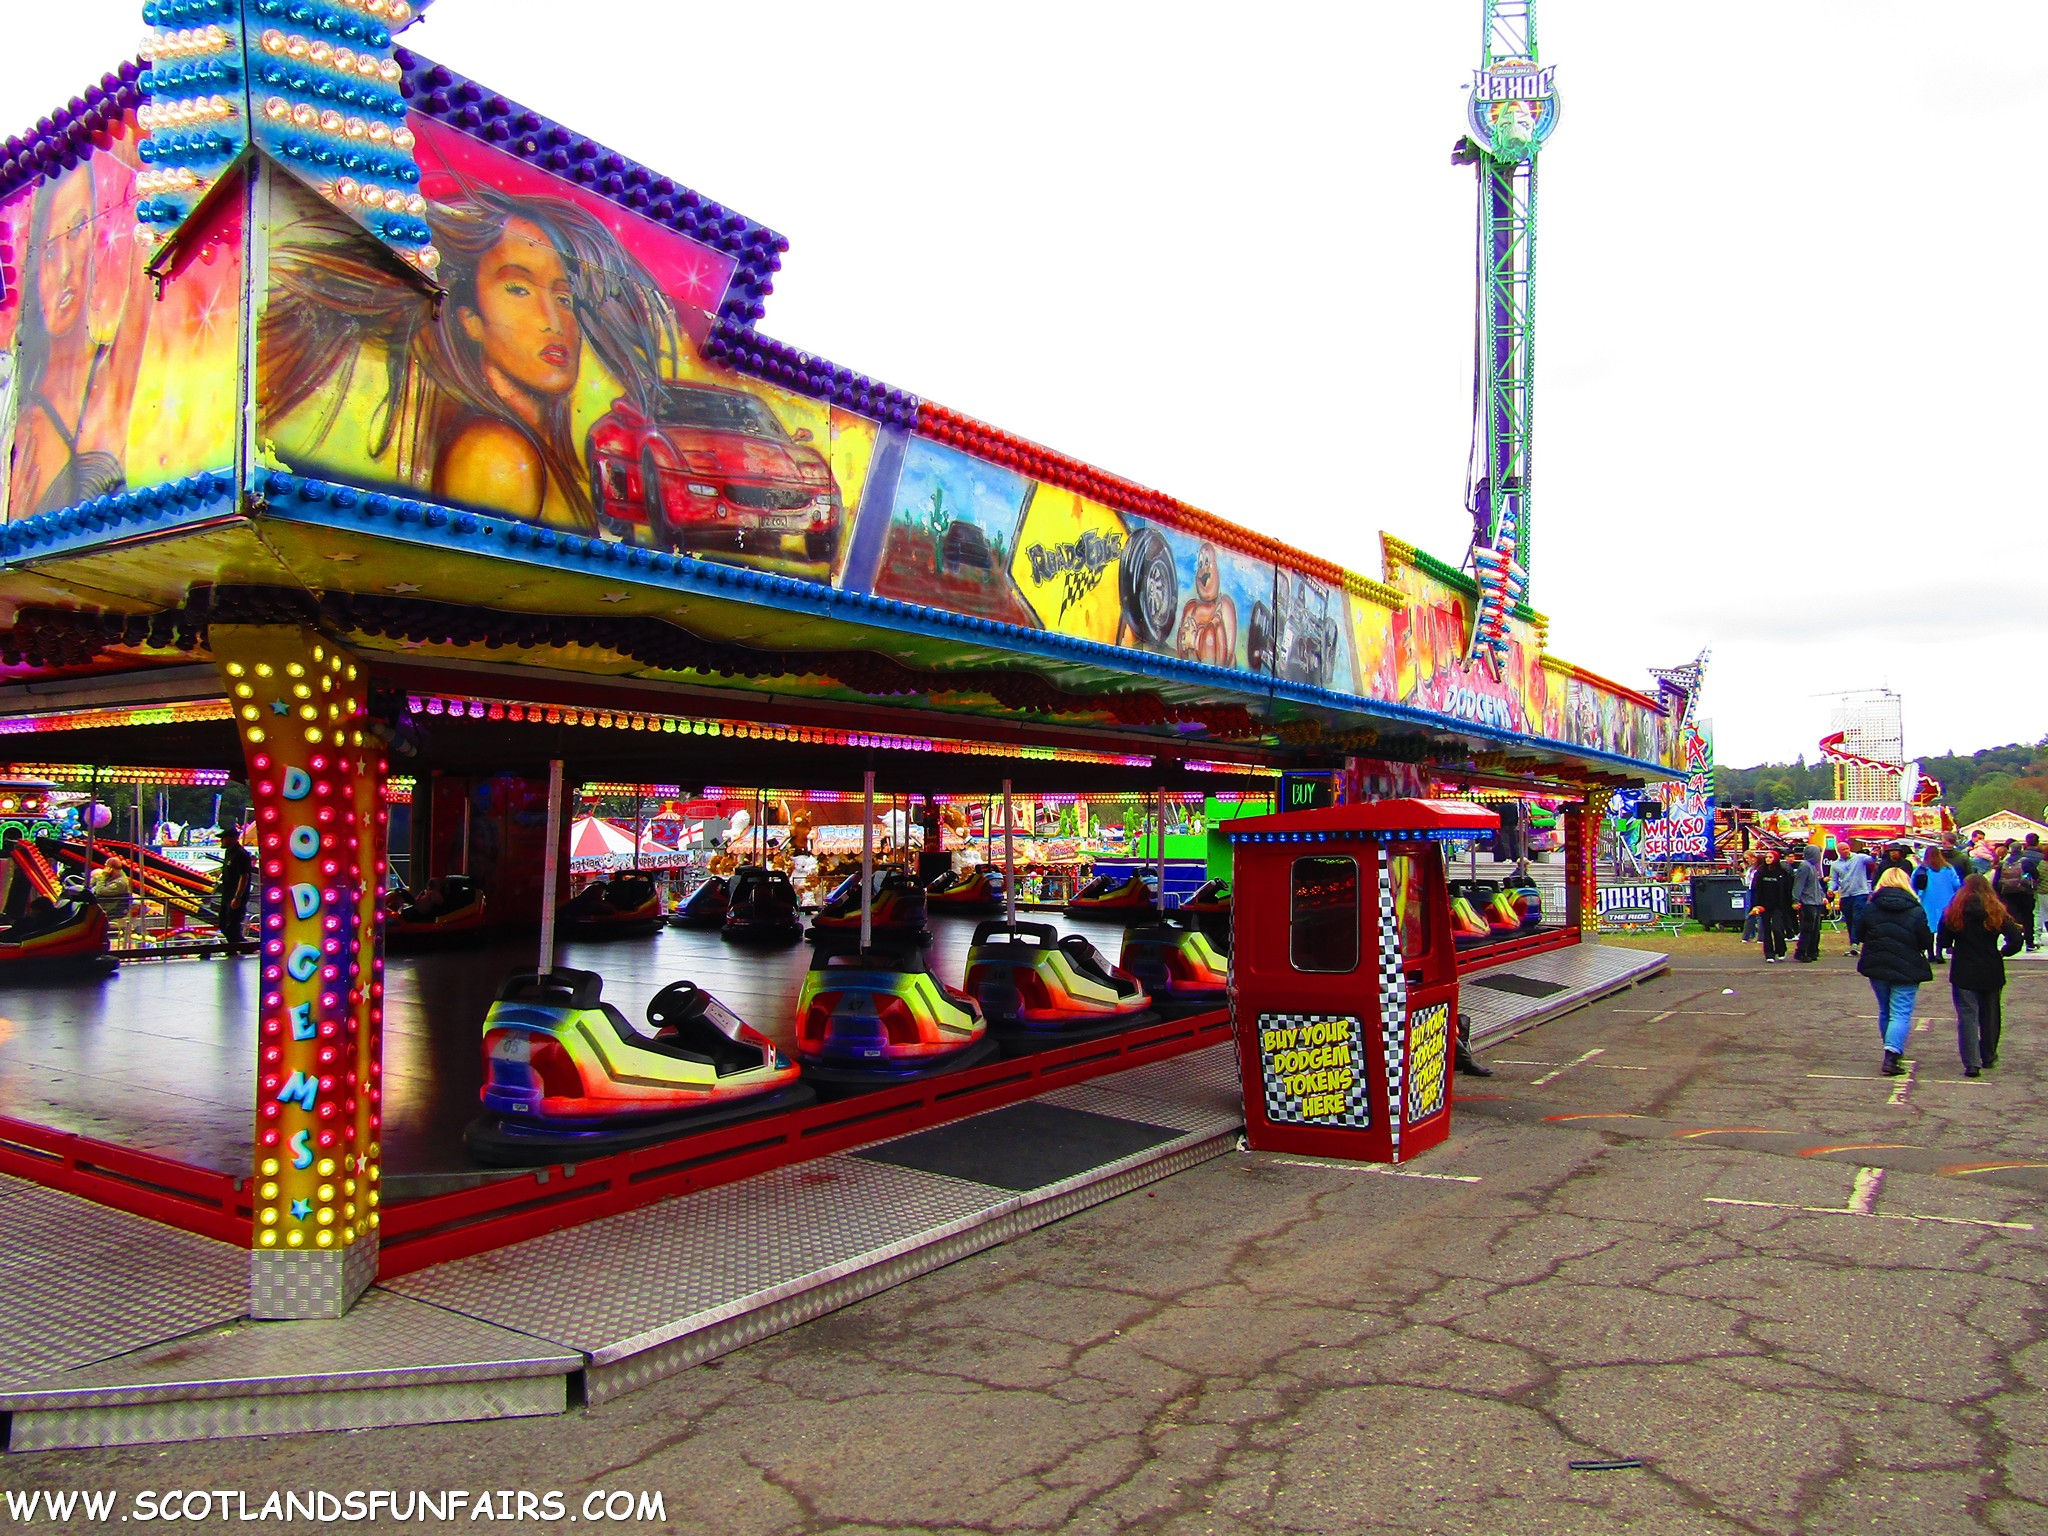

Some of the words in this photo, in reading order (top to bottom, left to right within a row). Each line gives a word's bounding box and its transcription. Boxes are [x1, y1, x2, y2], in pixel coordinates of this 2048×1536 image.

[1473, 64, 1558, 101] JOKER
[1442, 685, 1512, 730] DODGEMS
[1292, 782, 1316, 805] BUY
[1645, 818, 1680, 837] WHY
[1681, 816, 1705, 835] SO
[1860, 807, 1880, 821] THE
[818, 827, 862, 839] FUN
[1645, 837, 1708, 855] SERIOUS?
[1596, 887, 1668, 916] JOKER
[1628, 913, 1650, 921] RIDE
[278, 765, 322, 1171] DODGEMS
[1263, 1028, 1301, 1052] BUY
[1299, 1018, 1351, 1047] YOUR
[1411, 1024, 1424, 1051] BUY
[1423, 1007, 1445, 1037] YOUR
[1274, 1042, 1351, 1075] DODGEM
[1413, 1031, 1443, 1071] DODGEM
[1283, 1067, 1353, 1097] TOKENS
[1416, 1056, 1442, 1092] TOKENS
[1302, 1092, 1346, 1118] HERE
[1421, 1080, 1438, 1111] HERE
